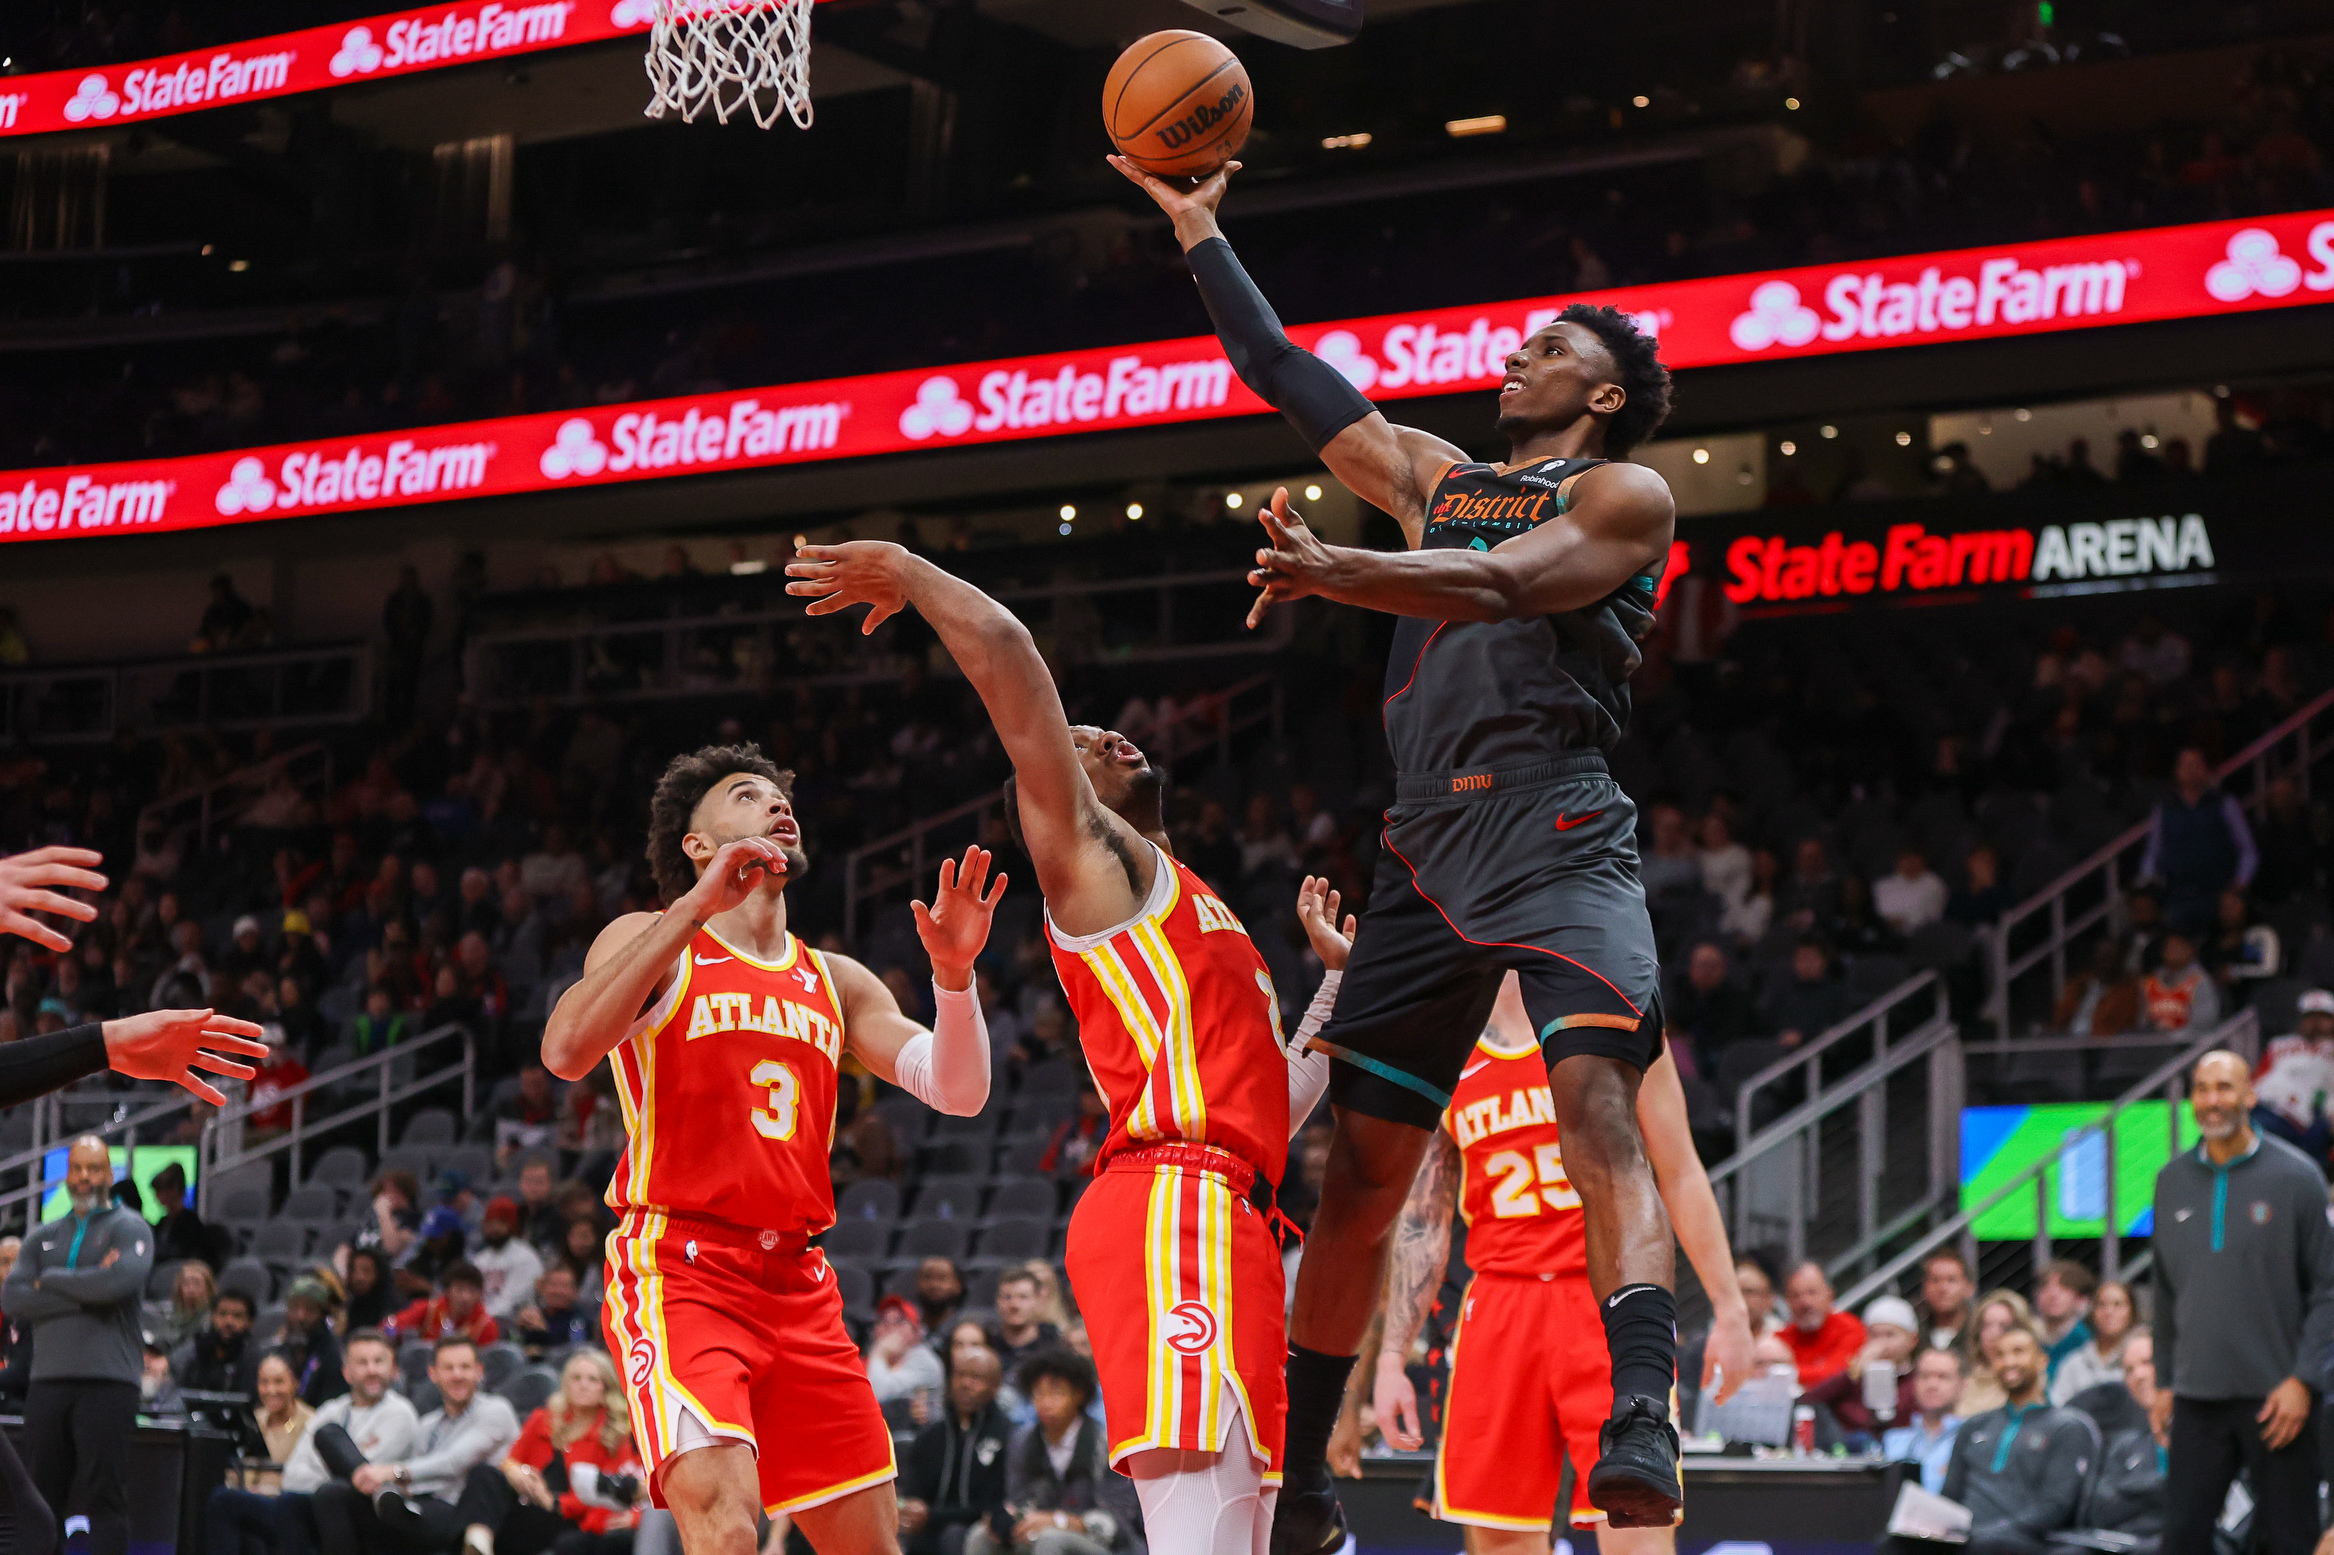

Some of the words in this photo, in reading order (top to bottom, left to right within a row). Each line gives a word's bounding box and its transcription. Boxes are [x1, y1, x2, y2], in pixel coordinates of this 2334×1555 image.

[1156, 82, 1245, 149] Wilson
[1430, 485, 1550, 522] District
[1520, 474, 1560, 488] Robinhood
[2033, 514, 2215, 581] ARENA
[1452, 774, 1493, 793] DMV
[686, 992, 841, 1072] ATLANTA
[750, 1058, 800, 1142] 3
[1485, 1142, 1583, 1219] 25
